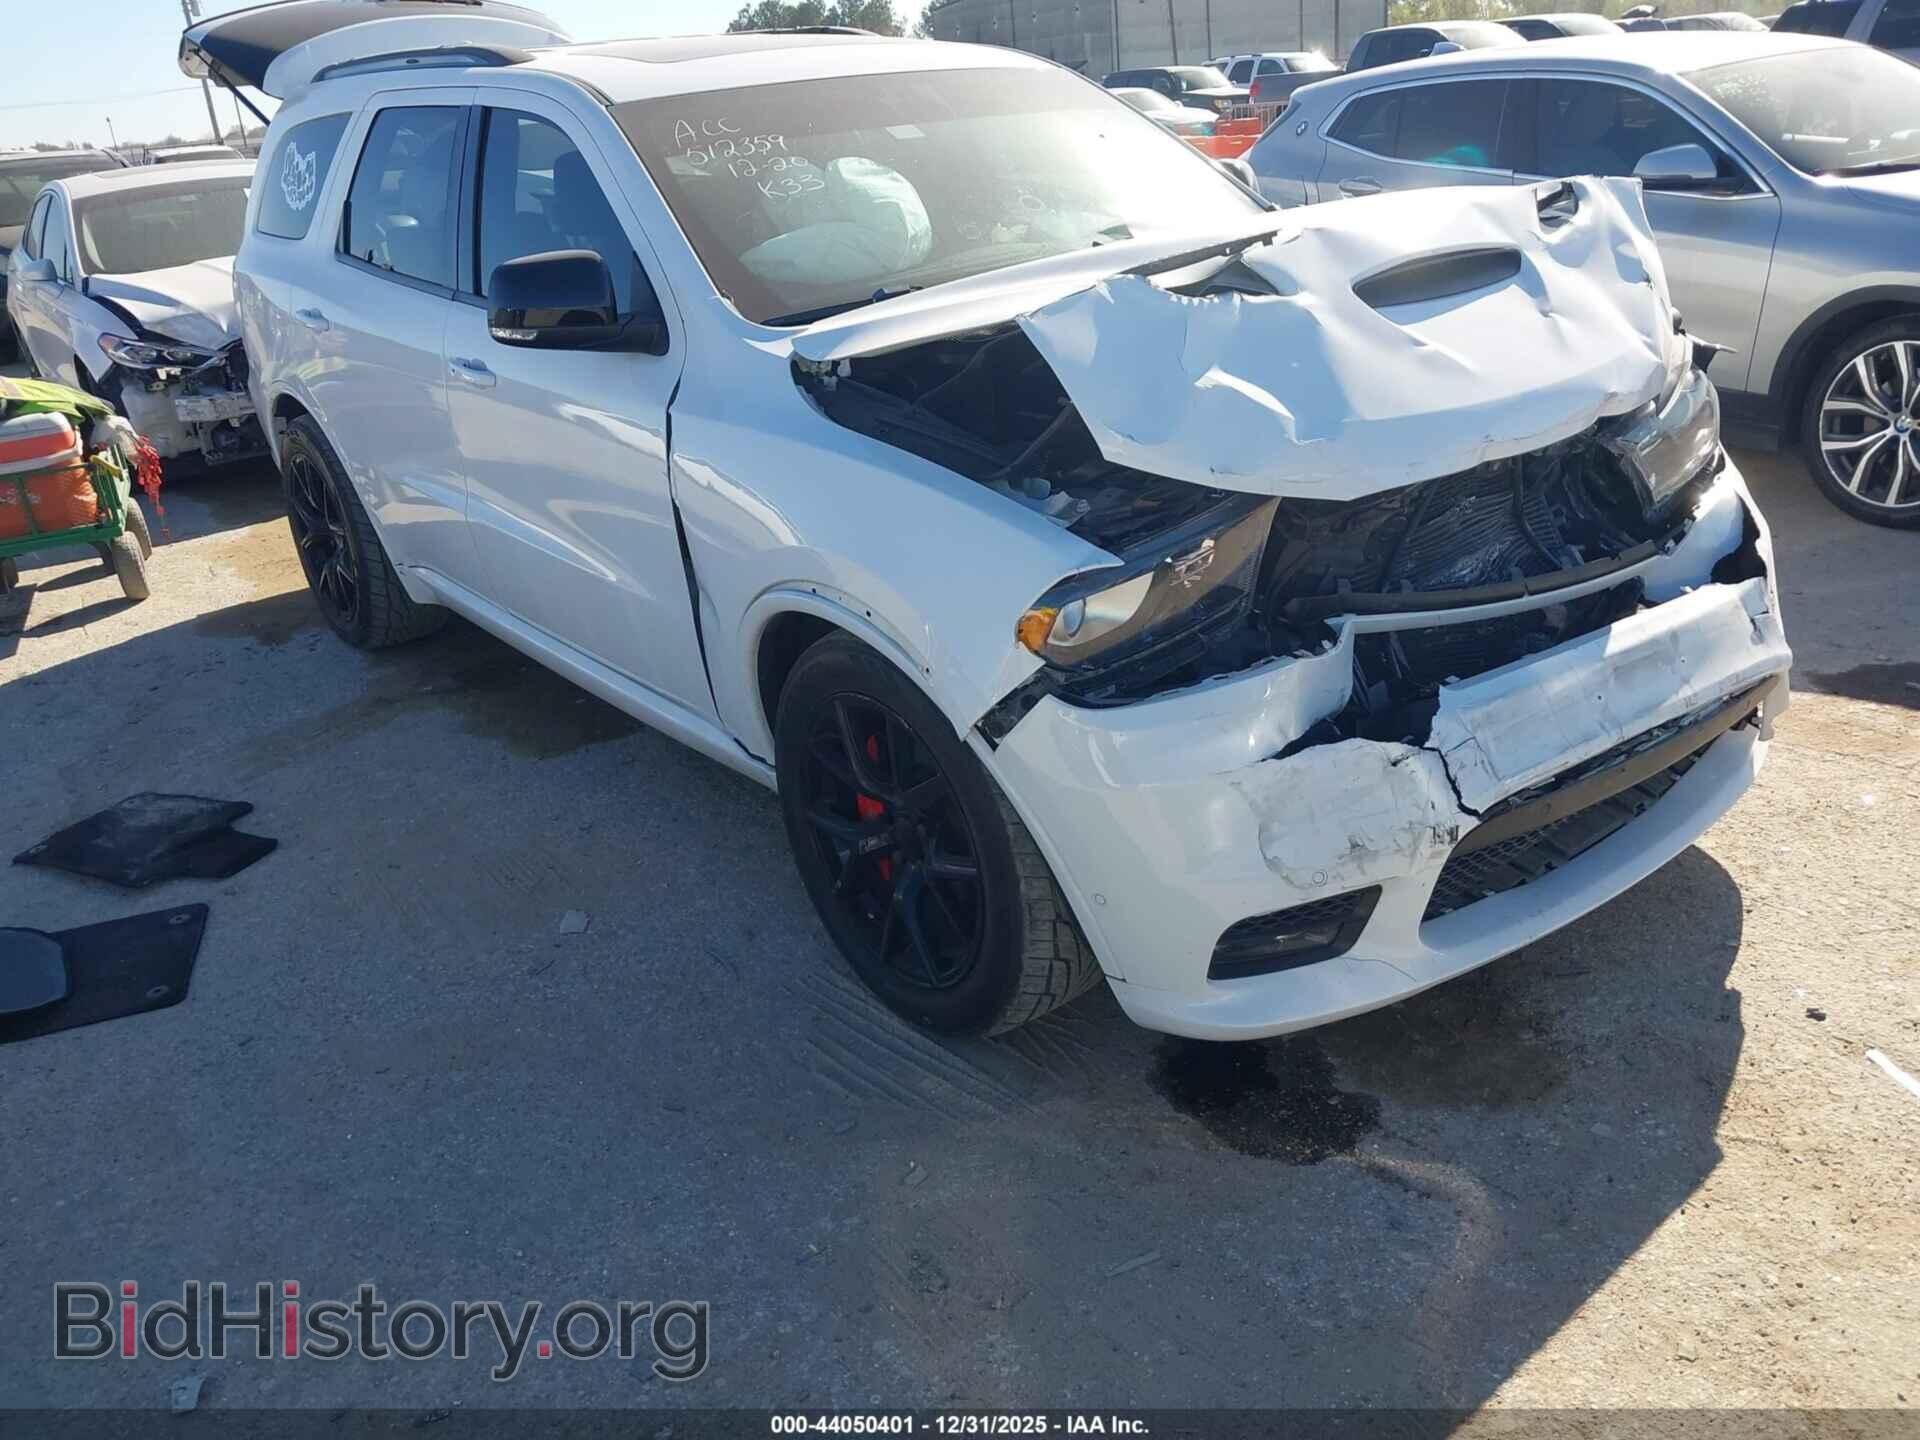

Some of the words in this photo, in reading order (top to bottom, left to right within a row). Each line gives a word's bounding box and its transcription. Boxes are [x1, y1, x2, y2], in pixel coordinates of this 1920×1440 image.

[674, 118, 742, 148] ACC
[686, 134, 789, 166] 512359
[727, 156, 809, 178] 12-20
[756, 173, 825, 199] K33
